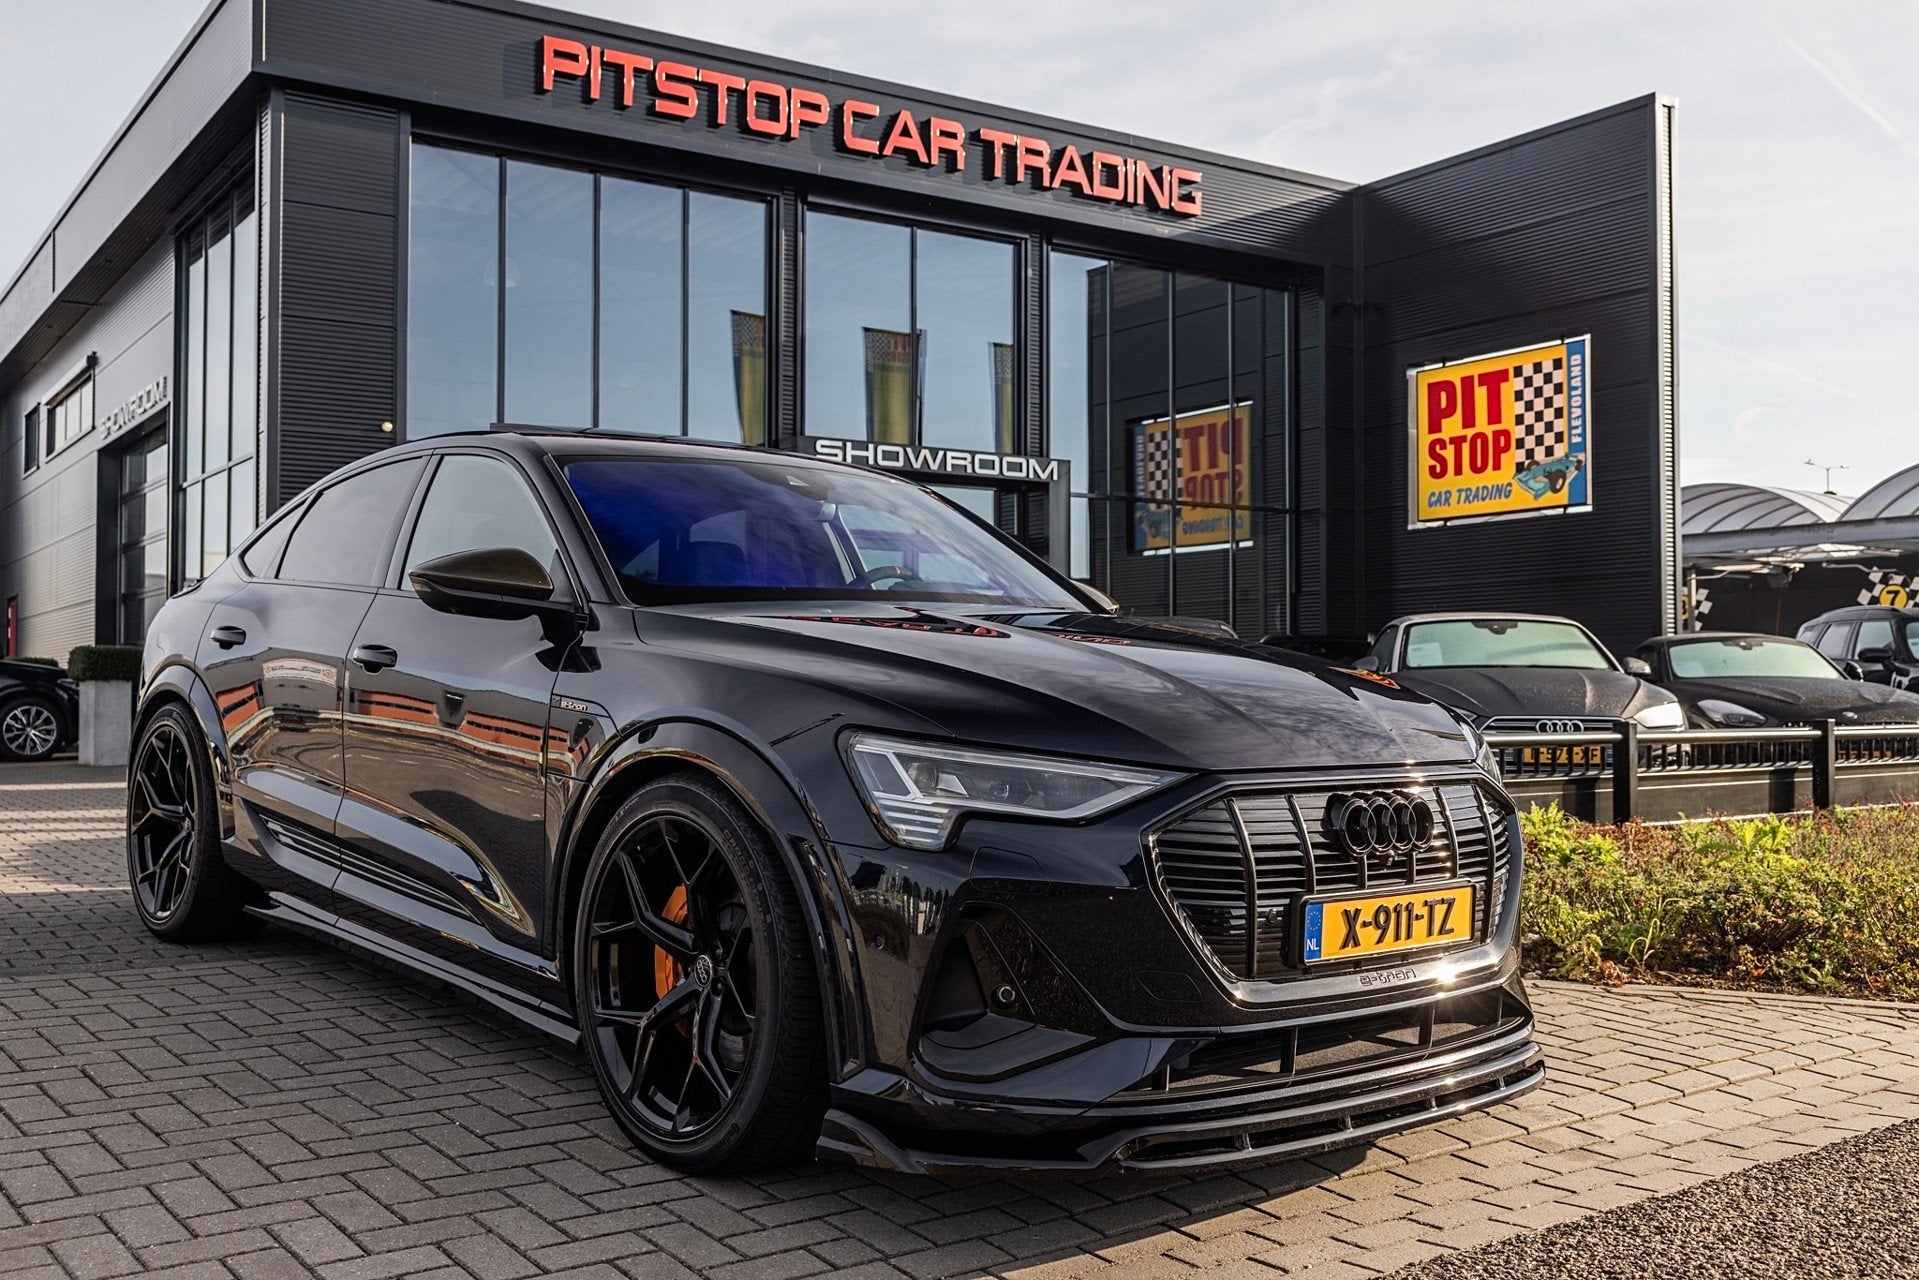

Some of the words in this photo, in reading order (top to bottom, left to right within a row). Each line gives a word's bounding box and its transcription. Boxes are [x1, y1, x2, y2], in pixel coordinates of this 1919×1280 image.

[542, 35, 830, 140] PITSTOP
[843, 100, 965, 171] CAR
[979, 128, 1203, 216] TRADING
[1427, 368, 1509, 435] PIT
[1571, 354, 1582, 444] FLEVOLAND
[815, 439, 1059, 481] SHOWROOM
[1428, 429, 1511, 480] STOP
[1427, 489, 1452, 508] CAR
[1456, 482, 1513, 505] TRADING
[1886, 590, 1900, 605] 7
[1306, 938, 1319, 951] NL
[1339, 897, 1456, 950] X-911-TZ
[1359, 968, 1416, 986] e-tron
